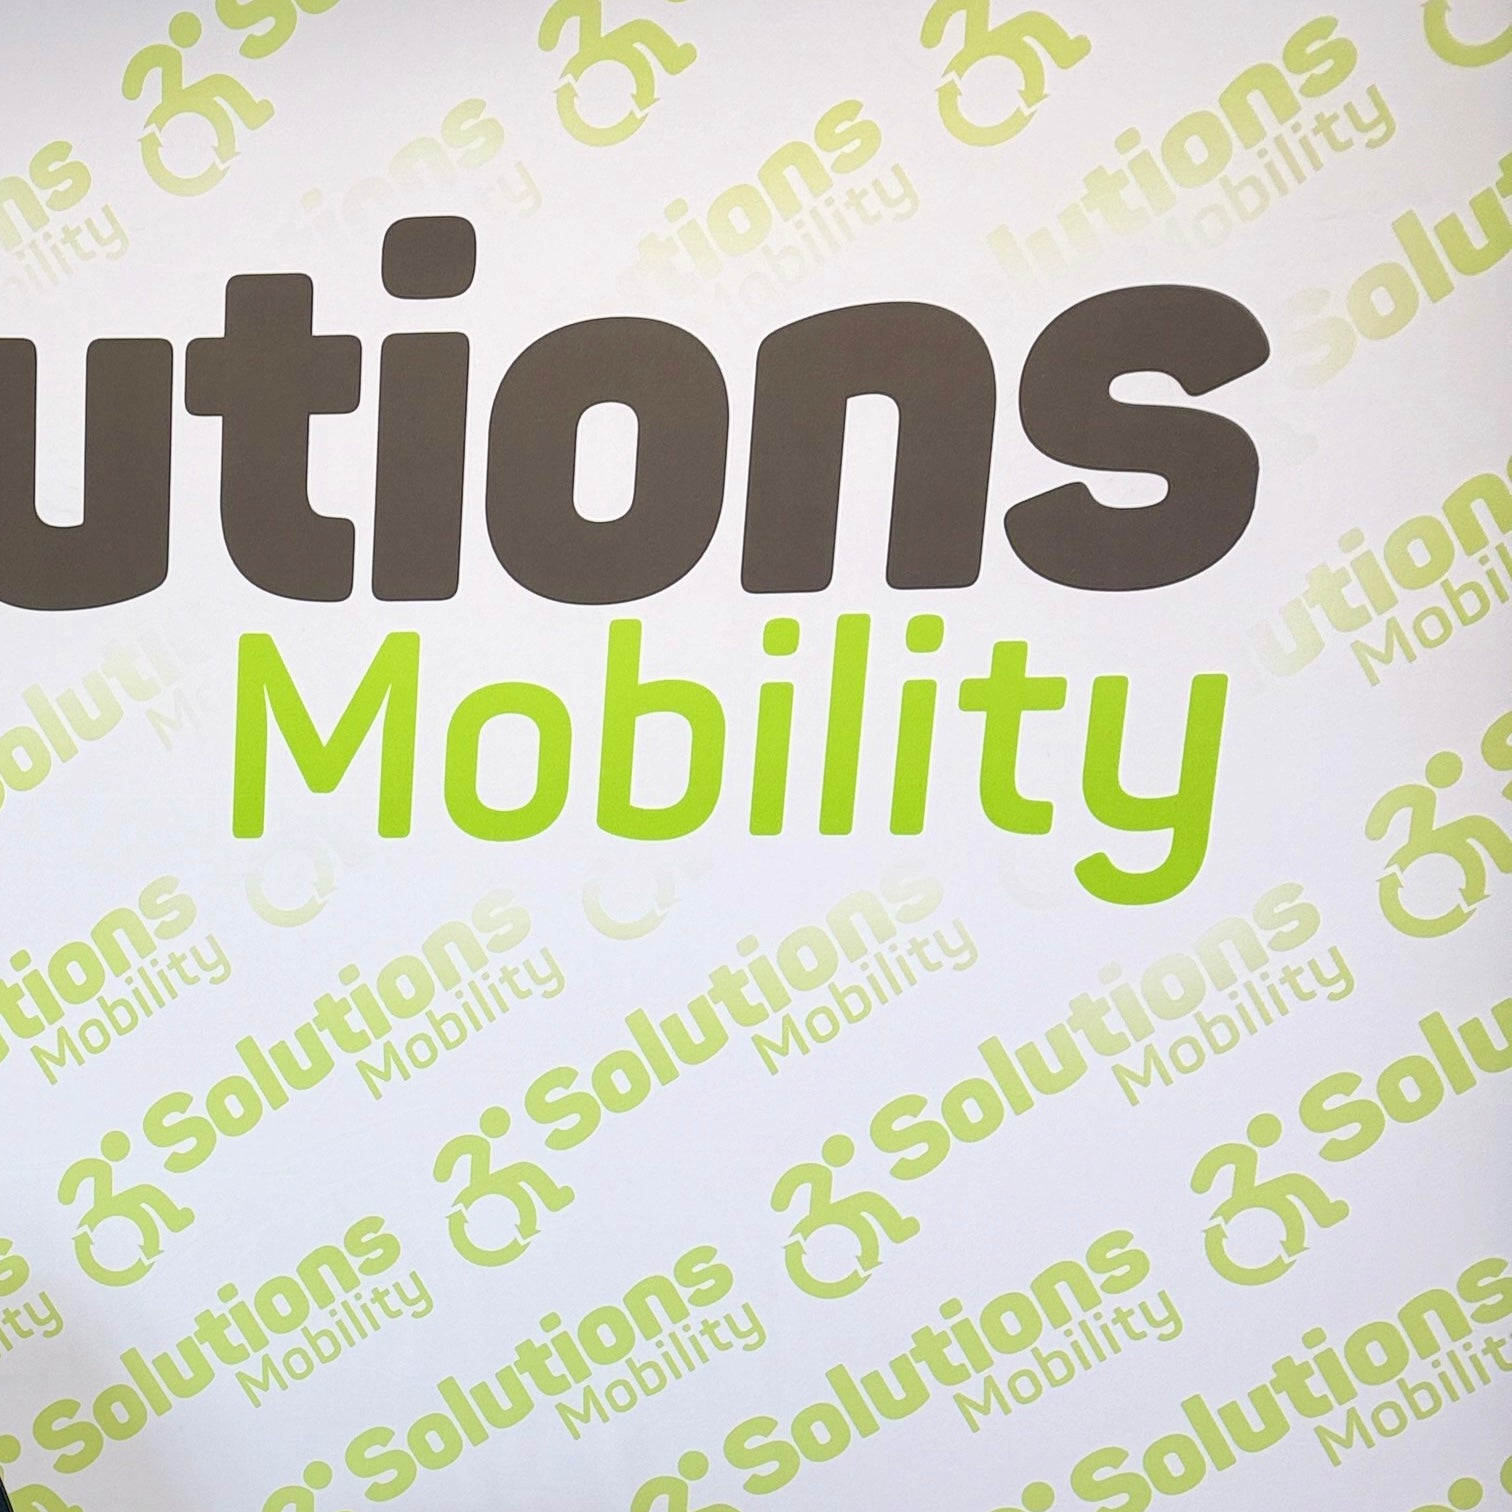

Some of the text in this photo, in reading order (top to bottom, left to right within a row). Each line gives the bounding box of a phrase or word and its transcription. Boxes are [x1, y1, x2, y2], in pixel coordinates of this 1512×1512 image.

[232, 613, 1228, 905] Mobility
[30, 933, 232, 1085] Mobility
[143, 889, 531, 1173] Solutions
[355, 946, 566, 1100] Mobility
[524, 862, 944, 1151] Solutions
[751, 917, 979, 1076] Mobility
[869, 883, 1321, 1181] Solutions
[1111, 946, 1355, 1107] Mobility
[33, 1215, 401, 1475] Solutions
[235, 1270, 434, 1409] Mobility
[344, 1245, 733, 1502] Solutions
[554, 1302, 767, 1440] Mobility
[723, 1230, 1151, 1495] Solutions
[952, 1289, 1184, 1433] Mobility
